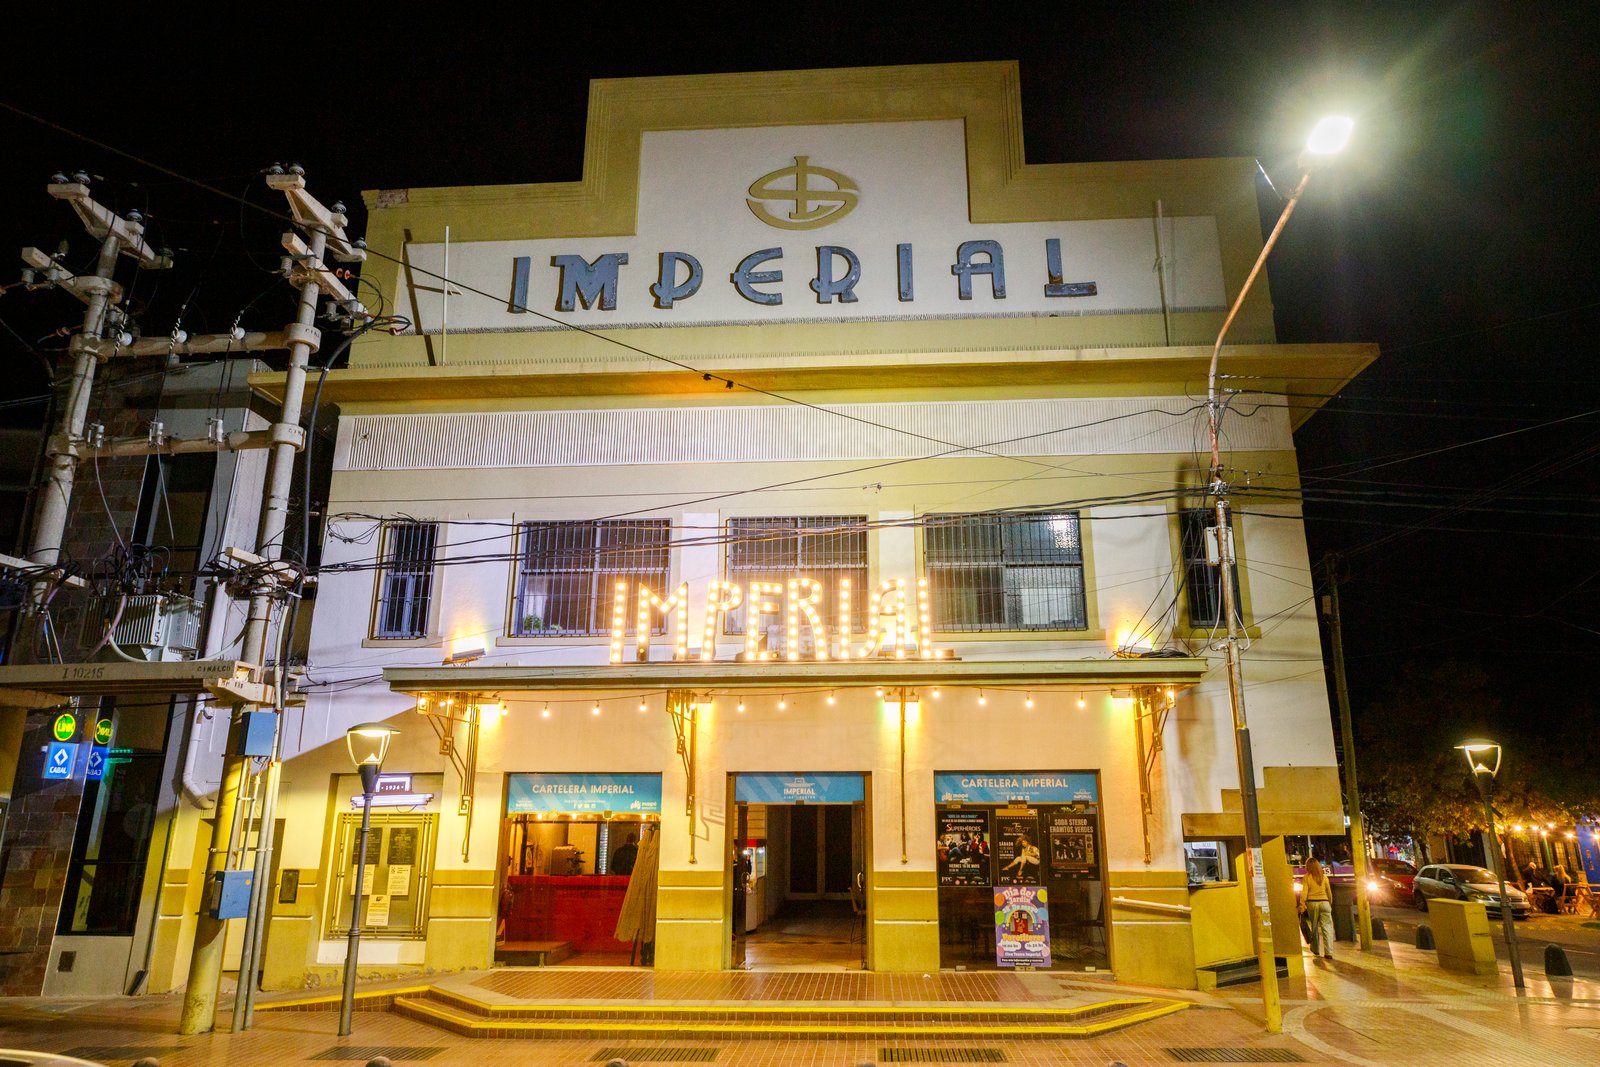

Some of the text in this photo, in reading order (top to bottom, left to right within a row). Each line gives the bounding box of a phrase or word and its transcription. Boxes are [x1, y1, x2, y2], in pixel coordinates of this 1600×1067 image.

[508, 238, 1097, 314] IMPERIAL
[608, 576, 956, 664] IMPERIAL
[961, 779, 1068, 788] CARTELERA IMPERIAL
[532, 784, 634, 794] CARTELERA IMPERIAL
[1054, 818, 1088, 826] SODA STEREO
